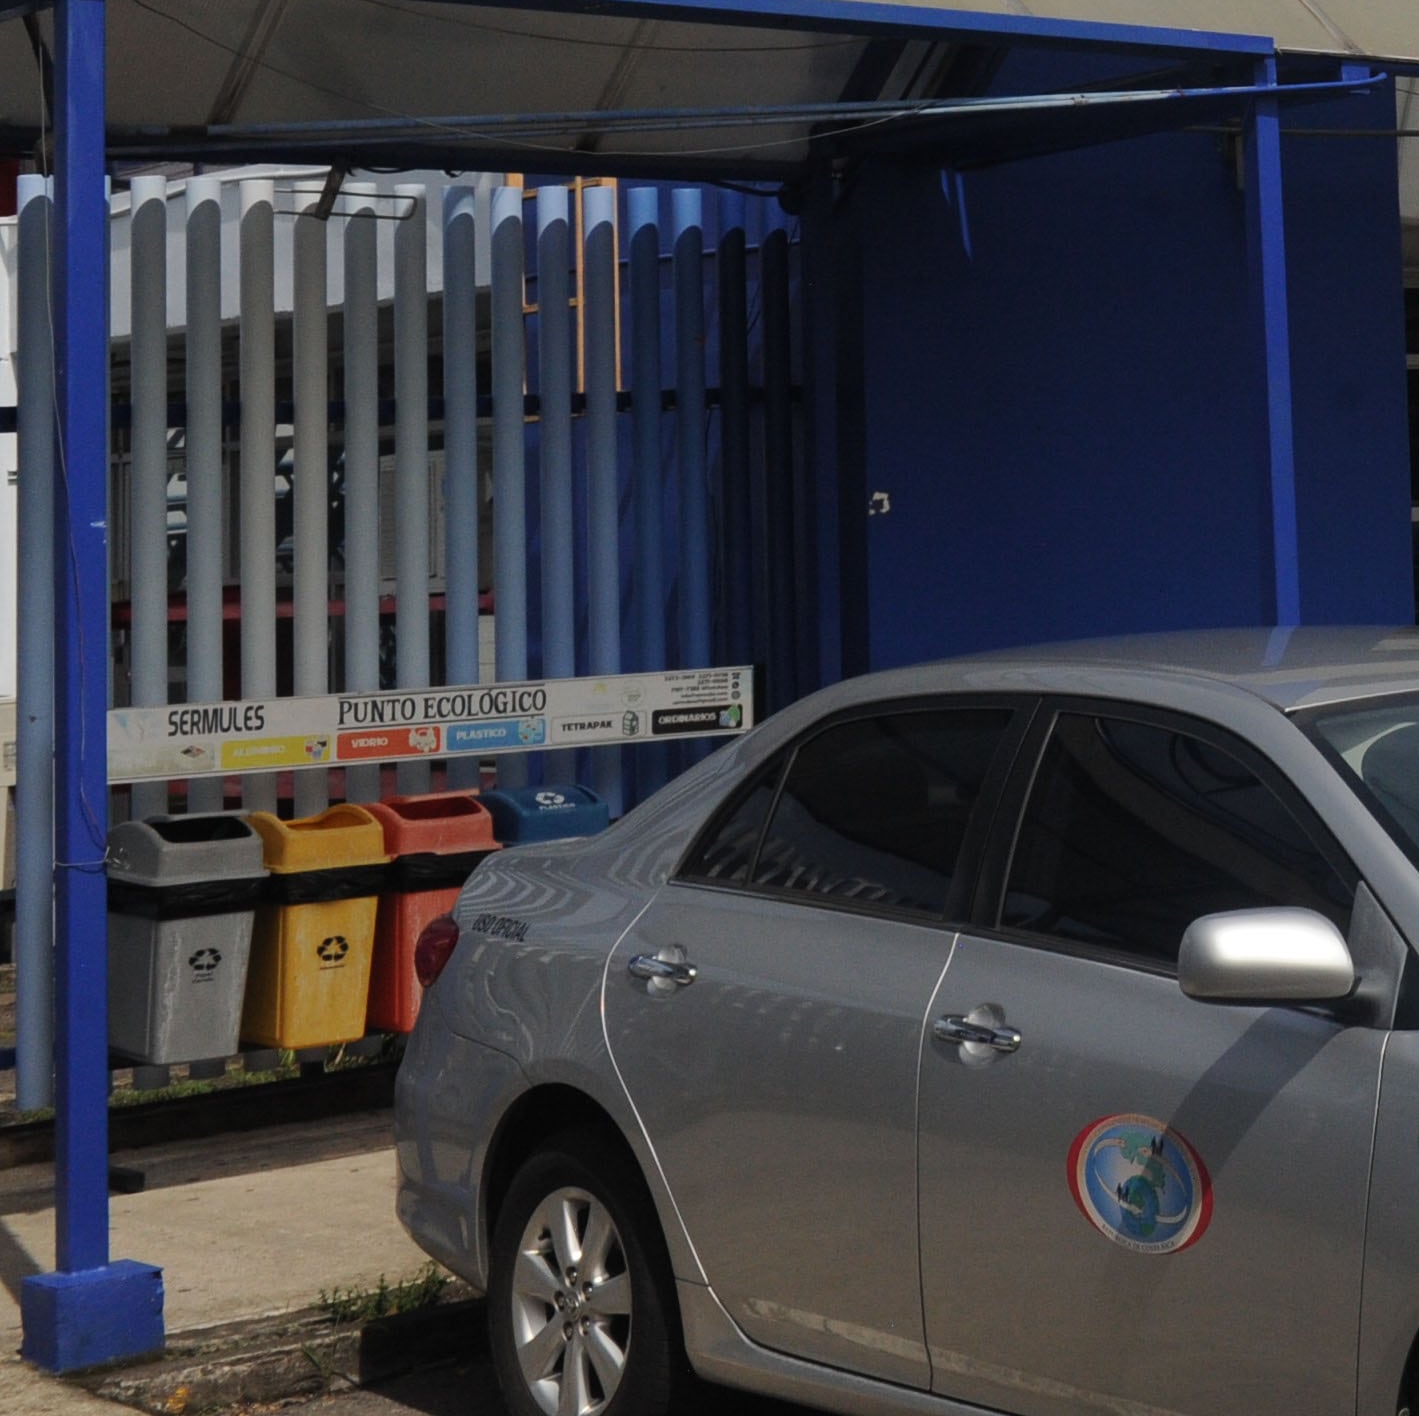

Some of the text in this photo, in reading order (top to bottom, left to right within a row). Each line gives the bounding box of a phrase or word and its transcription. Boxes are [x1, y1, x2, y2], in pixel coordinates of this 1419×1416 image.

[337, 687, 547, 725] PUNTO ECOLÓGICO
[168, 705, 265, 736] SERMULES
[561, 720, 614, 732] TETRAPAK
[351, 737, 389, 748] VIDRIO
